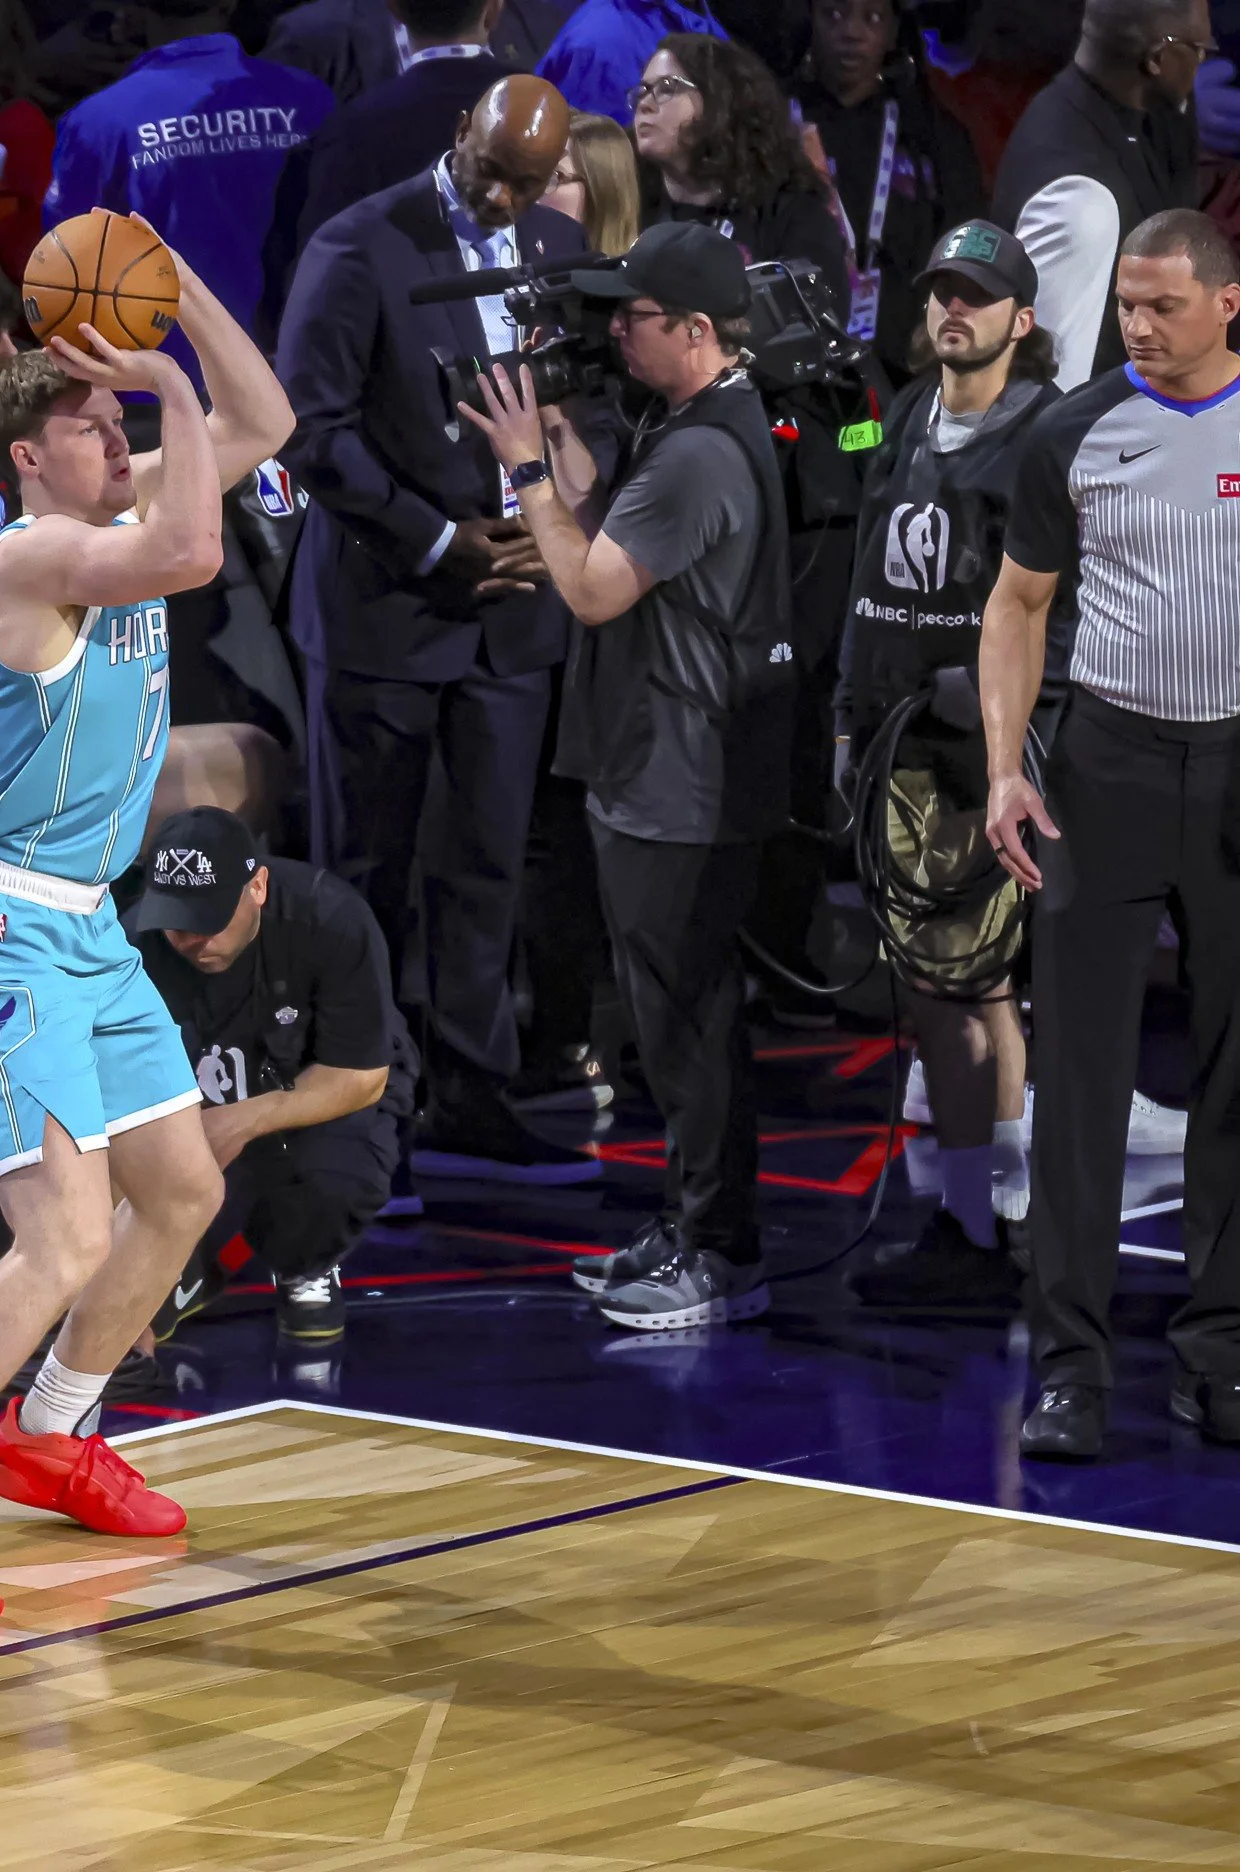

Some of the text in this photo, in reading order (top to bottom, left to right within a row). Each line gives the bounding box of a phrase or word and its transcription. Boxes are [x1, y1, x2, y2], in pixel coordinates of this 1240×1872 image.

[137, 107, 297, 148] SECURITY
[131, 132, 309, 170] FANDOM LIVES HER
[875, 604, 982, 630] NBC peacok
[141, 665, 170, 762] 7
[196, 851, 213, 873] LA
[173, 874, 187, 887] VS
[188, 873, 218, 887] WEST
